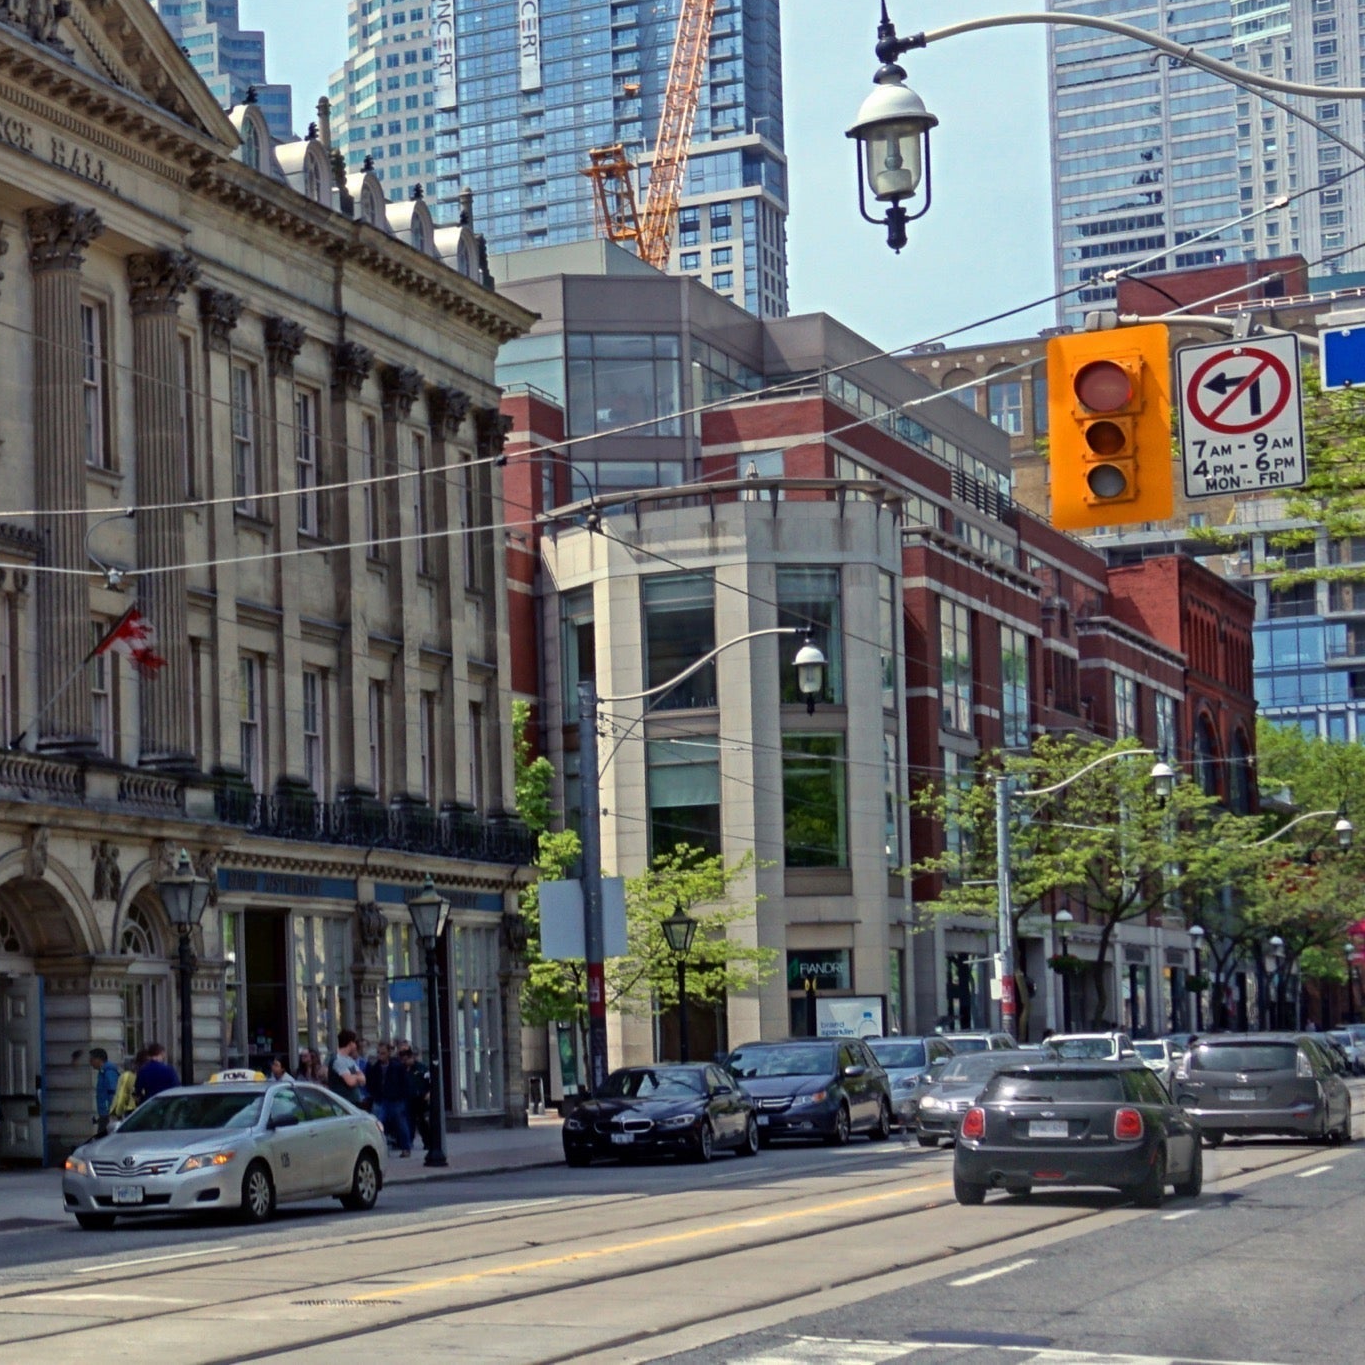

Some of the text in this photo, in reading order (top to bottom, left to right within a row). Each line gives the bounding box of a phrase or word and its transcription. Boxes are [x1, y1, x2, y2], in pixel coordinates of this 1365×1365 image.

[1210, 444, 1232, 457] AM
[1271, 437, 1293, 449] AM
[1274, 457, 1294, 469] PM
[1205, 476, 1240, 492] MON
[1259, 470, 1284, 485] FRI
